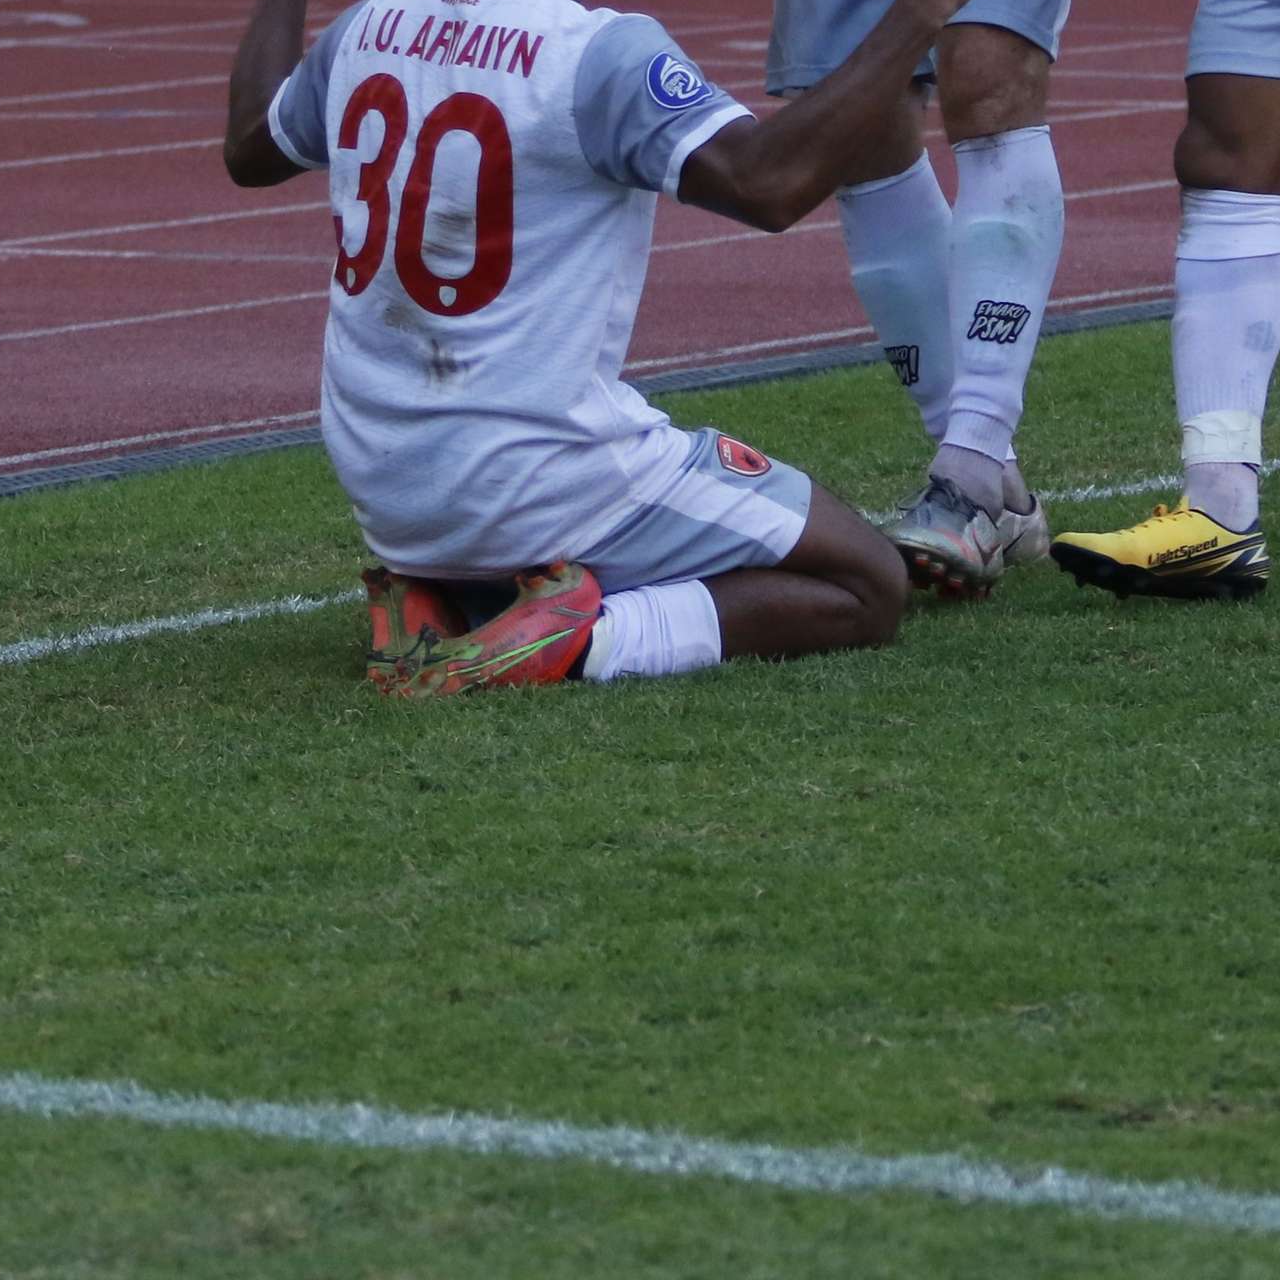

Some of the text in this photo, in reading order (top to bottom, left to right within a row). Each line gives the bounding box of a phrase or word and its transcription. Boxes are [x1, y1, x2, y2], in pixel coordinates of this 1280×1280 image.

[332, 72, 515, 317] 30
[975, 302, 1025, 318] EWAKO
[968, 312, 1030, 342] PSM!
